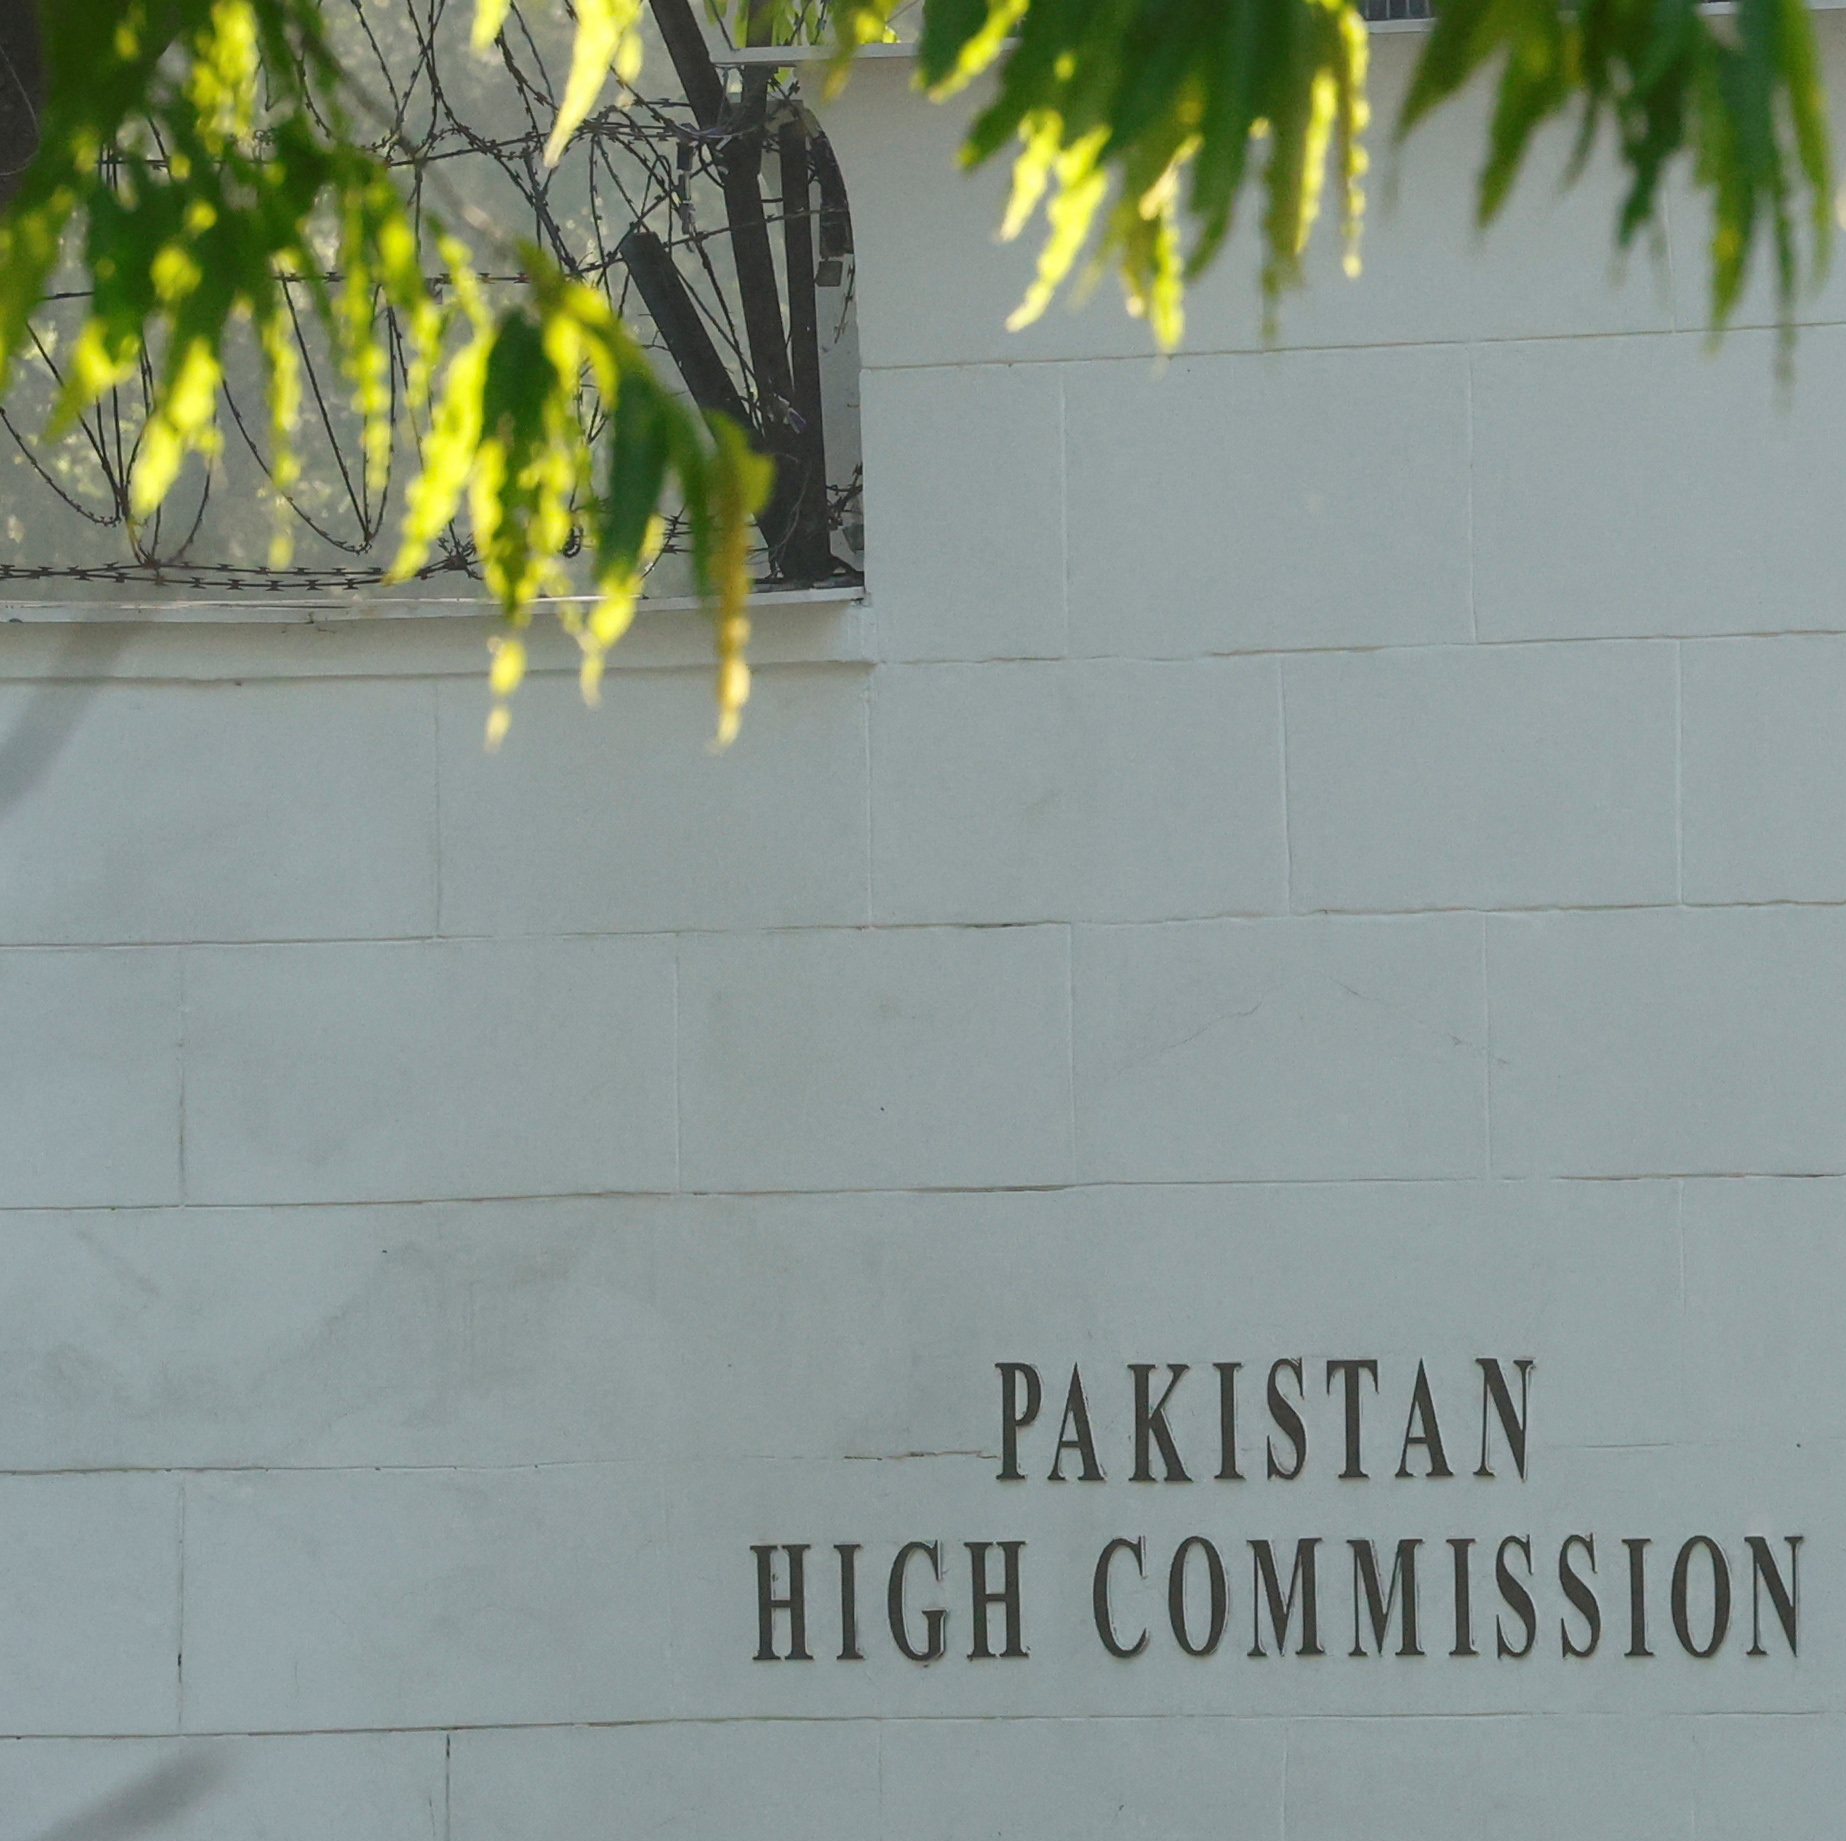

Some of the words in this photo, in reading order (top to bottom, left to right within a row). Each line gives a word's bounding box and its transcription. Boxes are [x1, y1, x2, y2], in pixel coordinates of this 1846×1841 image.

[993, 1356, 1535, 1484] PAKISTAN
[748, 1538, 1030, 1664] HIGH
[1091, 1532, 1805, 1661] COMMISSION
